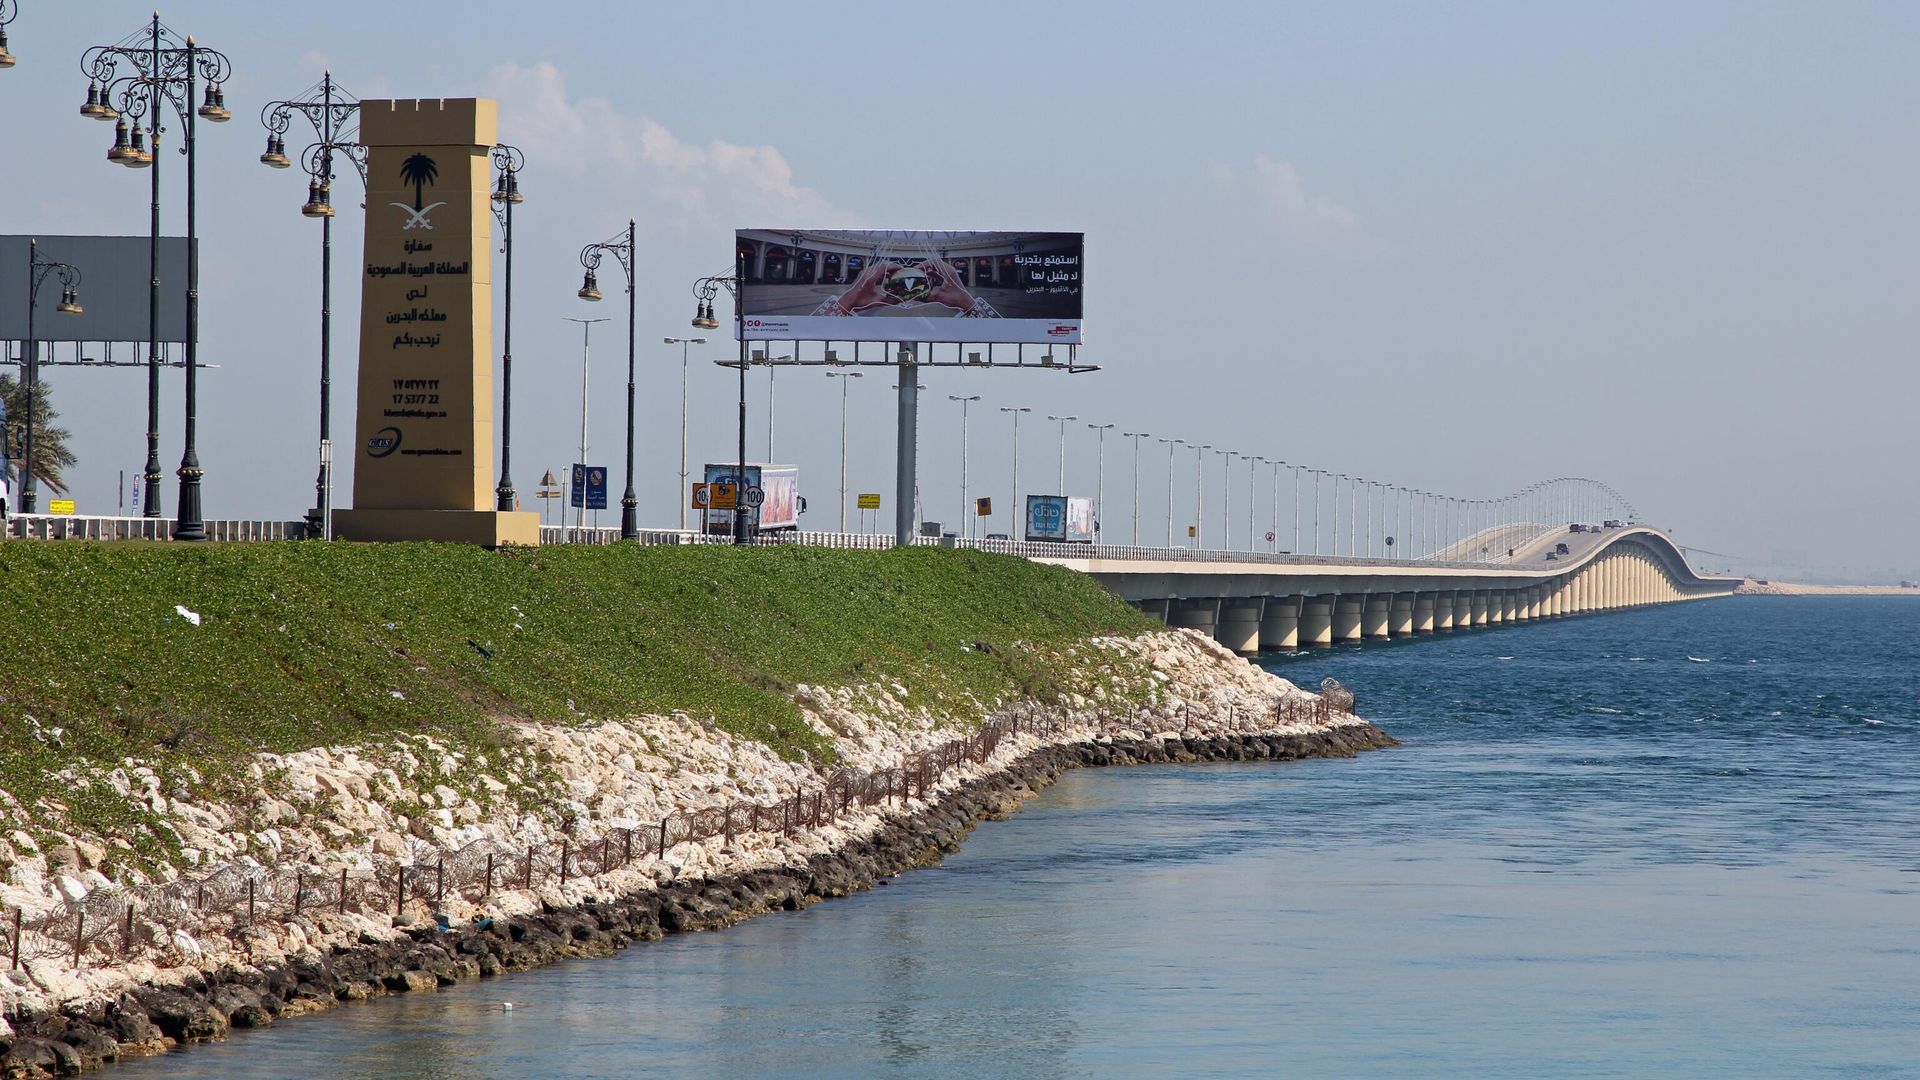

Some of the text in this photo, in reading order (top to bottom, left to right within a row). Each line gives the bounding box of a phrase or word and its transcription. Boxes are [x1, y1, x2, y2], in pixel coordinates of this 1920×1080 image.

[404, 239, 432, 254] سفارة
[1014, 255, 1078, 266] استمتع بتجربة
[367, 262, 468, 278] المملكة العربية السعودية
[1031, 270, 1078, 282] لا مثيل لها
[386, 308, 418, 324] البحرين
[393, 332, 441, 349] ترحب بكم
[428, 394, 440, 404] 22
[747, 491, 761, 503] 100
